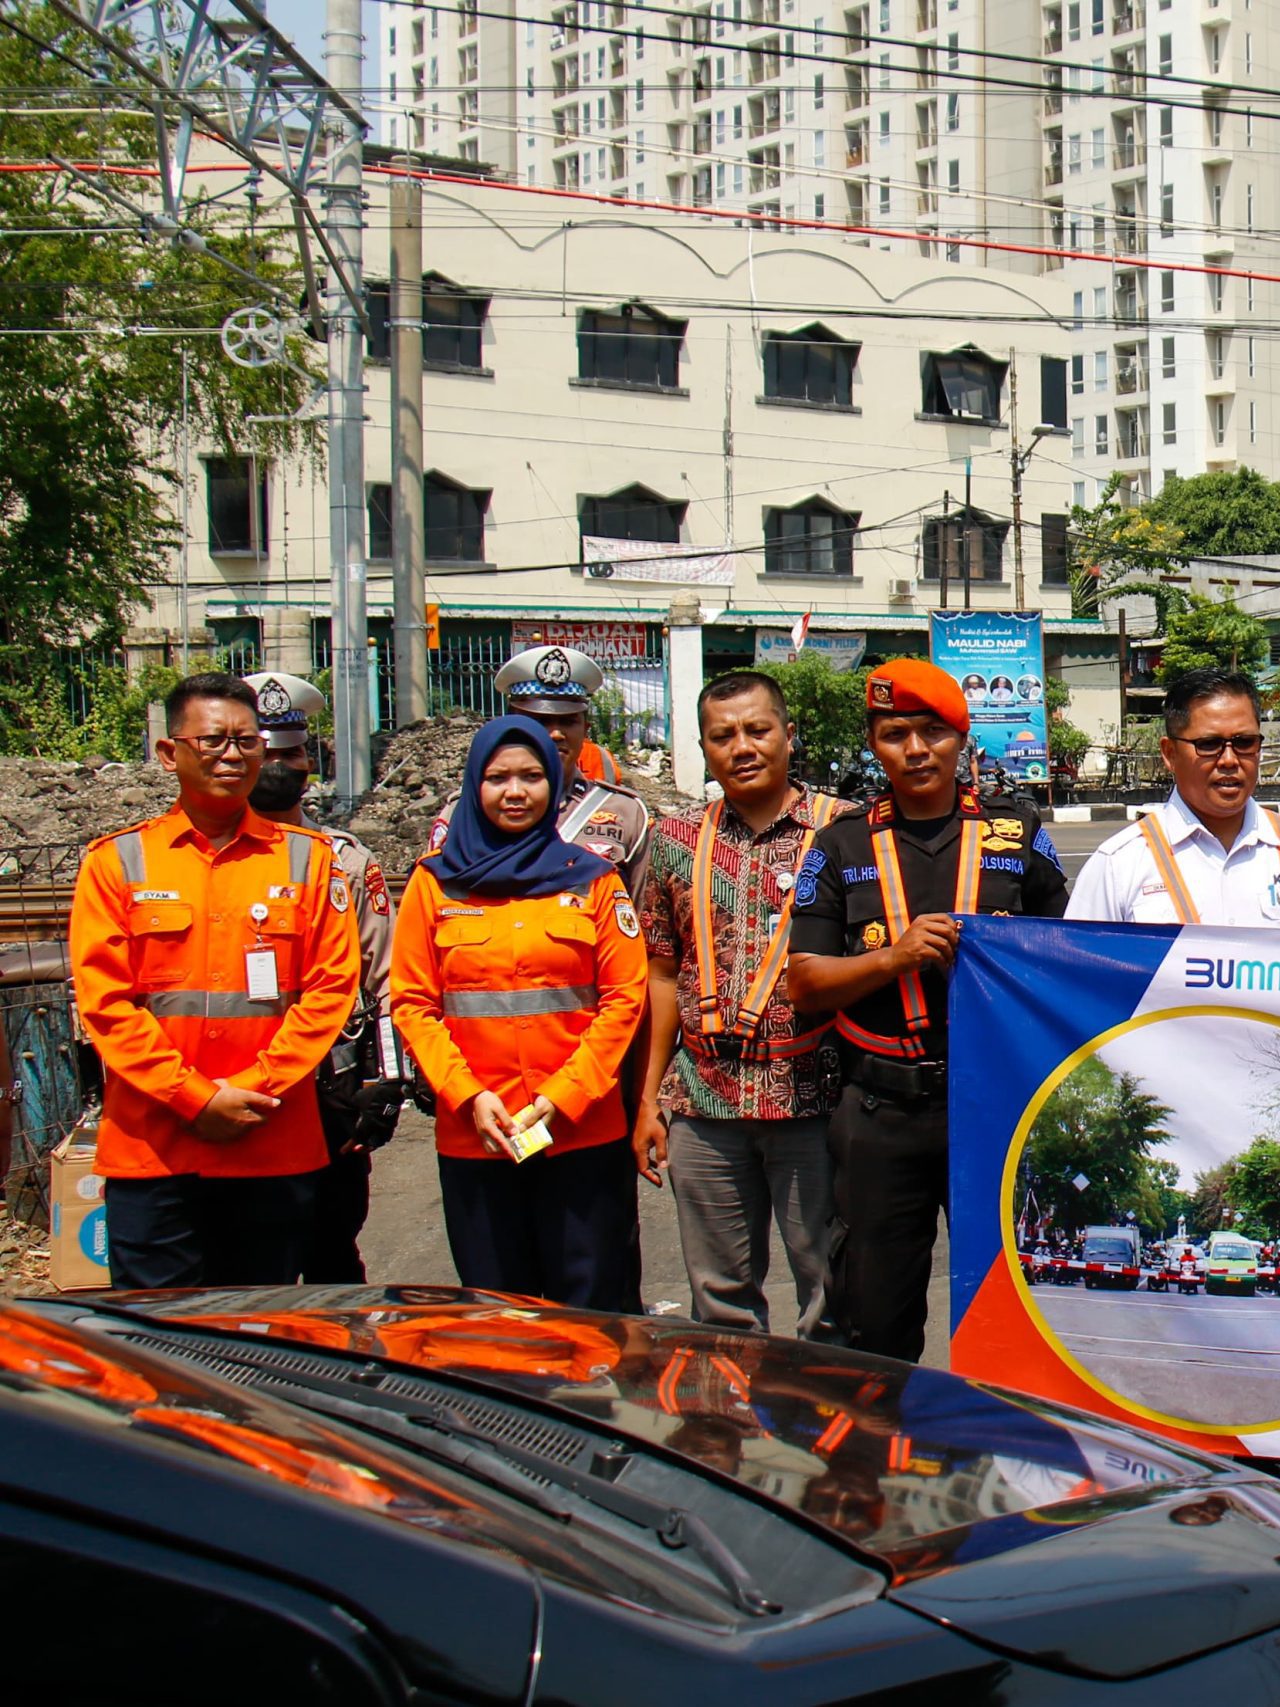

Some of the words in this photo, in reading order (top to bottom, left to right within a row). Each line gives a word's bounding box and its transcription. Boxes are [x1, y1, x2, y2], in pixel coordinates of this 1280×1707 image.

[546, 624, 644, 638] DIJUAL
[948, 639, 994, 648] MAULID
[996, 640, 1027, 648] NABI
[580, 825, 623, 841] OLRI
